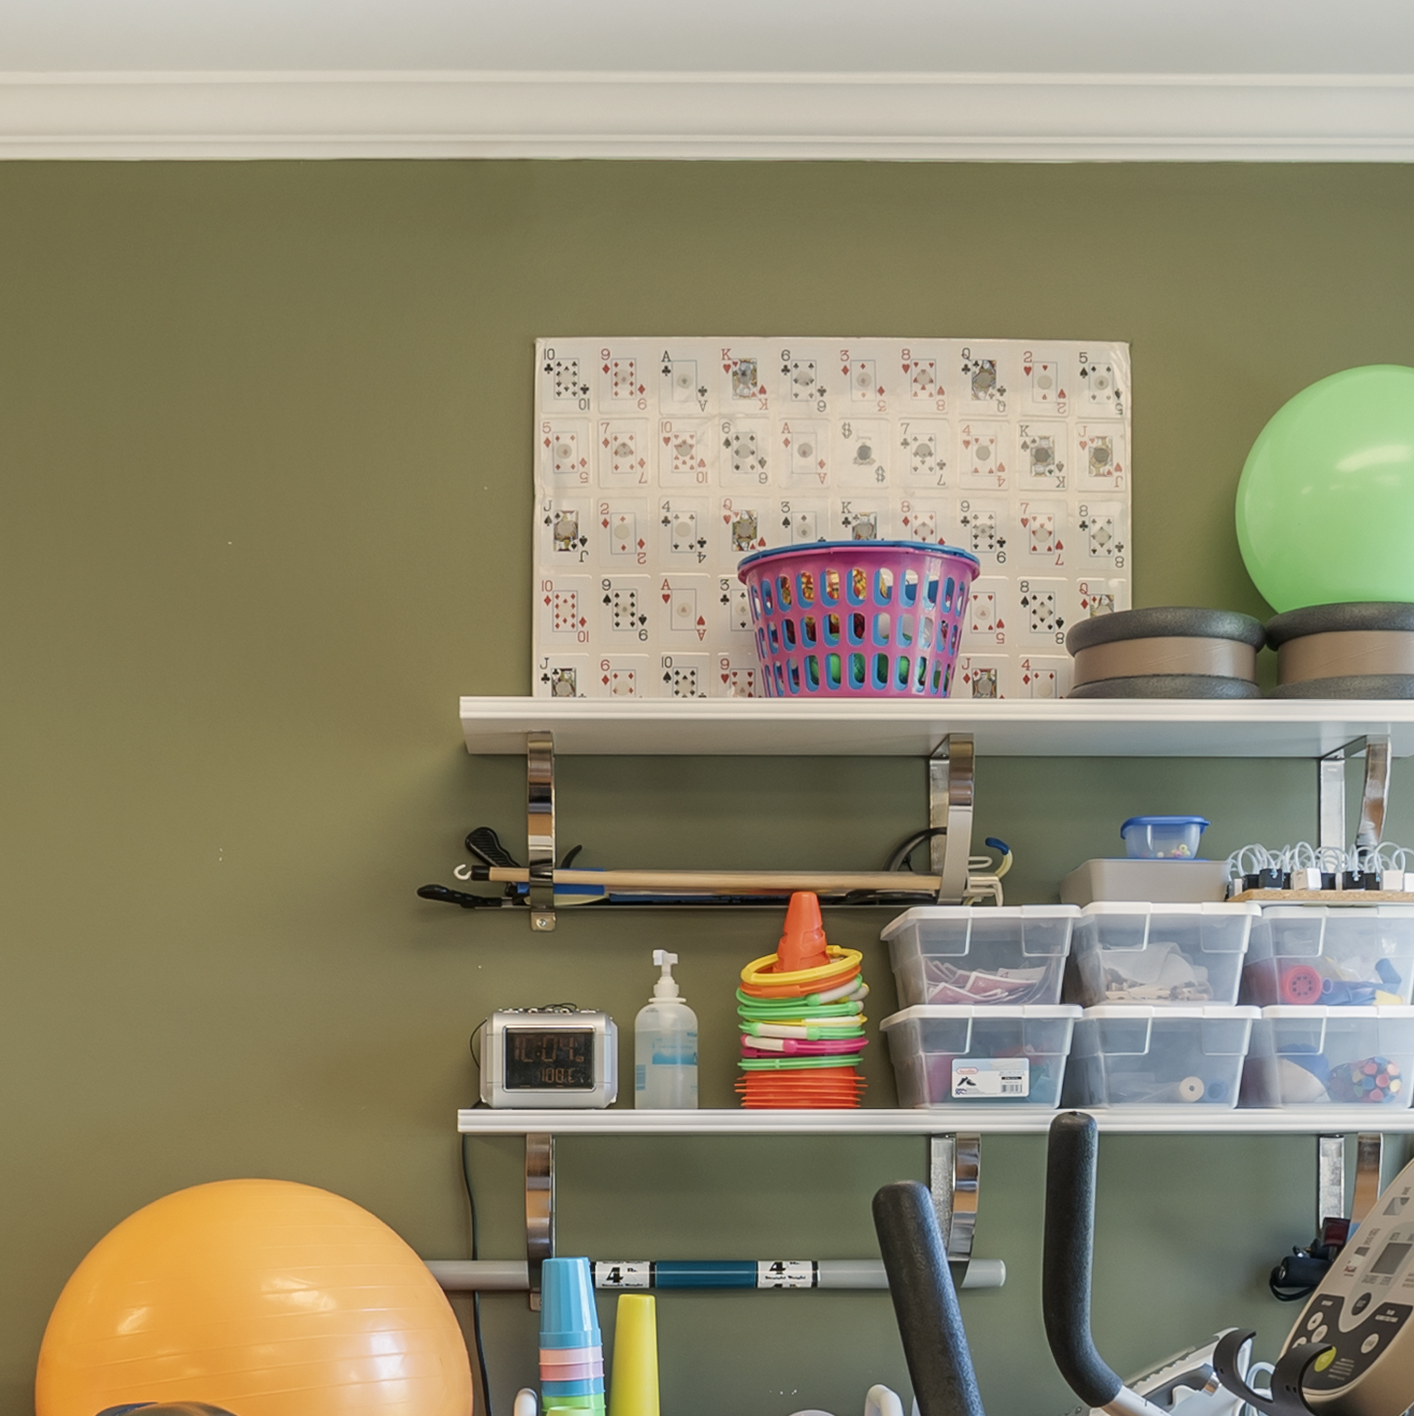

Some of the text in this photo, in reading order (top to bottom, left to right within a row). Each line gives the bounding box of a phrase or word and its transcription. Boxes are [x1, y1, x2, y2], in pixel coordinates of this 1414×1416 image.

[544, 349, 554, 360] 10
[601, 349, 610, 360] 9
[662, 350, 671, 362] A
[722, 349, 731, 360] K
[782, 350, 790, 361] 6
[840, 350, 849, 361] 3
[902, 350, 910, 360] 8
[962, 348, 972, 360] Q
[1024, 352, 1032, 362] 2
[1079, 352, 1088, 363] 5
[579, 399, 590, 410] 10
[698, 400, 708, 412] A
[759, 400, 768, 410] K
[878, 400, 886, 411] 3
[937, 400, 946, 411] 8
[996, 400, 1006, 412] Q
[1057, 402, 1066, 413] 2
[1115, 403, 1123, 414] 5
[543, 422, 551, 433] 5
[601, 423, 610, 434] 7
[661, 422, 672, 433] 10
[722, 423, 731, 434] 6
[782, 422, 791, 434] A
[901, 423, 910, 434] 7
[962, 424, 971, 436] 4
[1020, 426, 1030, 436] K
[1078, 426, 1087, 437] J
[580, 472, 588, 483] 5
[638, 473, 647, 484] 7
[696, 472, 708, 483] 10
[818, 473, 826, 484] A
[937, 474, 946, 486] 7
[997, 476, 1006, 487] 4
[1056, 476, 1066, 488] K
[1114, 476, 1123, 487] J
[544, 500, 552, 511] J
[600, 504, 609, 514] 2
[662, 502, 670, 512] 4
[723, 498, 733, 510] Q
[781, 502, 790, 512] 3
[841, 502, 851, 513] K
[902, 502, 910, 512] 8
[961, 501, 970, 512] 9
[1021, 503, 1029, 514] 7
[1080, 506, 1088, 516] 8
[579, 551, 588, 562] J
[637, 552, 646, 564] 2
[697, 552, 706, 563] 4
[1055, 554, 1064, 565] 7
[1115, 556, 1124, 568] 8
[542, 580, 553, 592] 10
[602, 580, 611, 590] 9
[661, 579, 670, 590] A
[720, 580, 729, 590] 3
[1020, 581, 1029, 592] 8
[1080, 582, 1089, 594] Q
[578, 631, 589, 642] 10
[697, 629, 706, 640] A
[996, 633, 1005, 644] 5
[1056, 632, 1064, 644] 8
[540, 658, 549, 669] J
[601, 660, 610, 670] 6
[662, 657, 672, 668] 10
[720, 658, 729, 669] 9
[962, 658, 971, 670] J
[1022, 659, 1030, 670] 4
[769, 1261, 786, 1274] 4
[606, 1267, 624, 1283] 4
